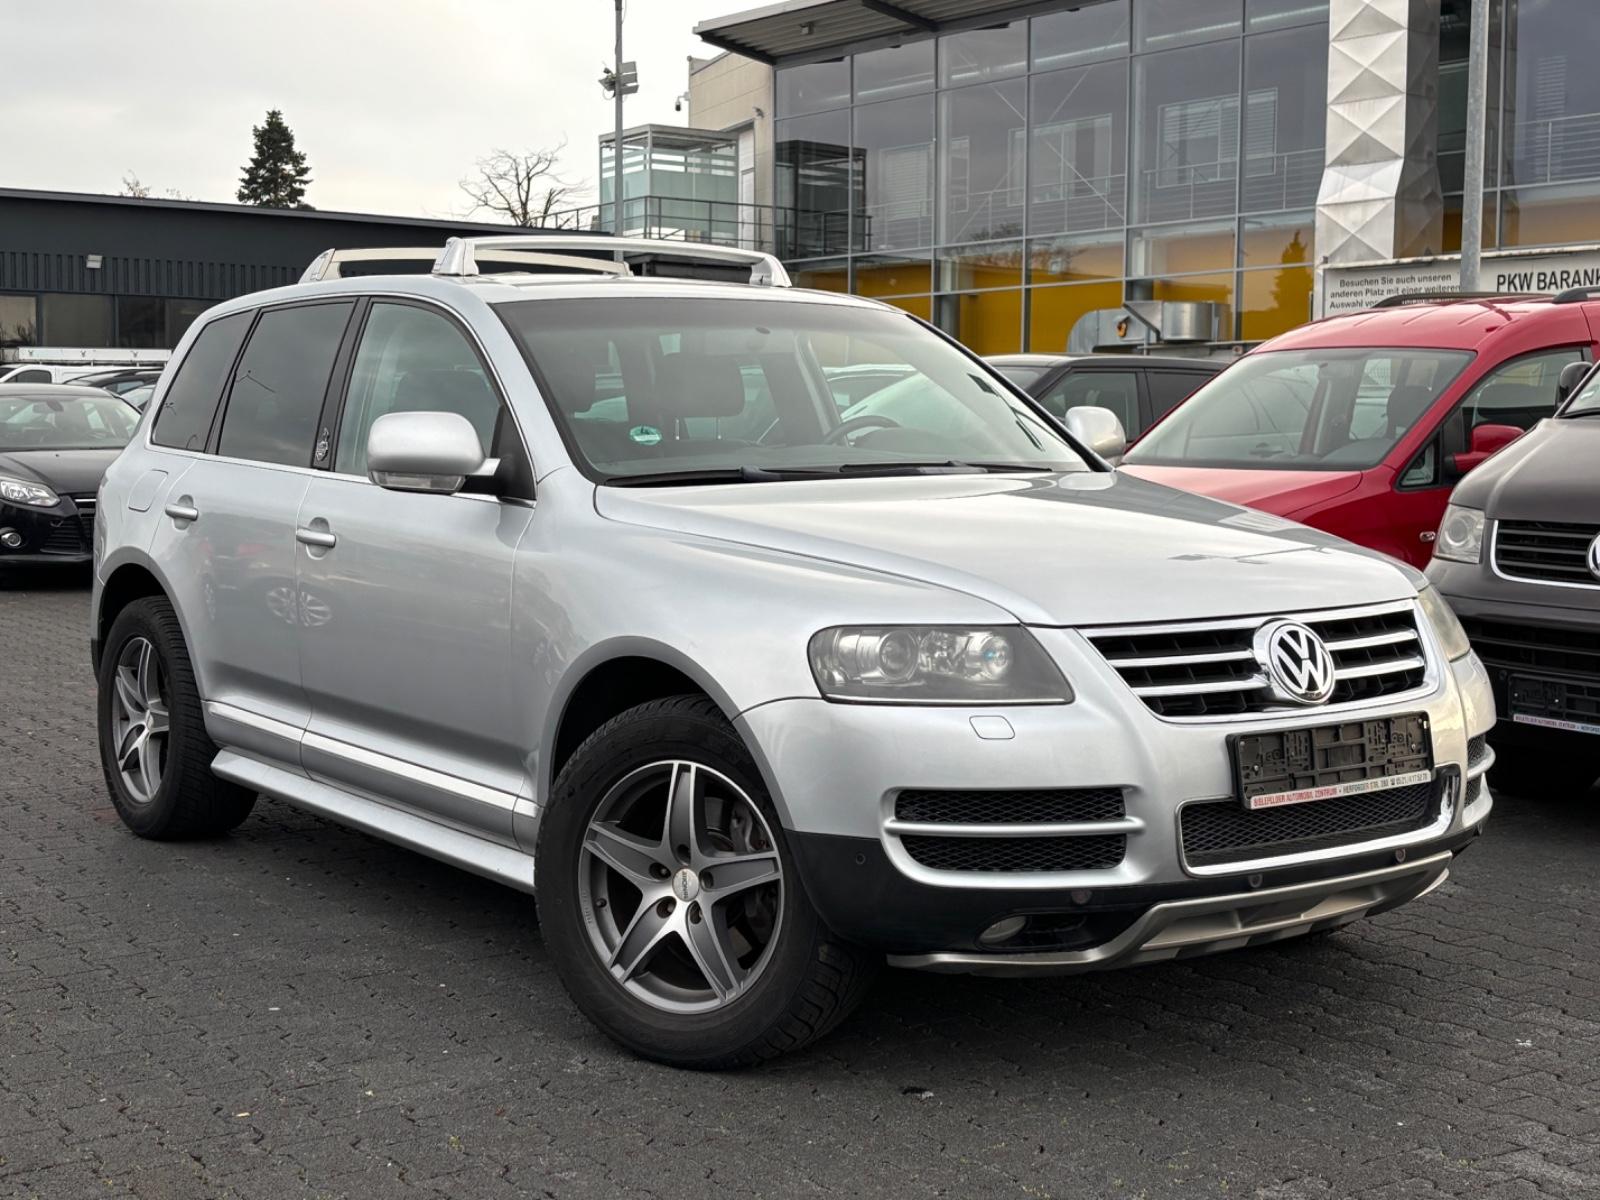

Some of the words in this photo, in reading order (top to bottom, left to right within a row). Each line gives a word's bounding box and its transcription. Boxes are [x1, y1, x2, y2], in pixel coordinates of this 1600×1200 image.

[1339, 277, 1379, 288] Besuchen
[1381, 275, 1394, 285] Sie
[1395, 274, 1416, 284] auch
[1417, 273, 1452, 283] unseren
[1496, 271, 1534, 292] PKW
[1330, 288, 1364, 299] anderen
[1365, 286, 1385, 297] Platz
[1386, 285, 1399, 295] mit
[1401, 284, 1422, 295] einer
[1329, 298, 1364, 309] Auswahl
